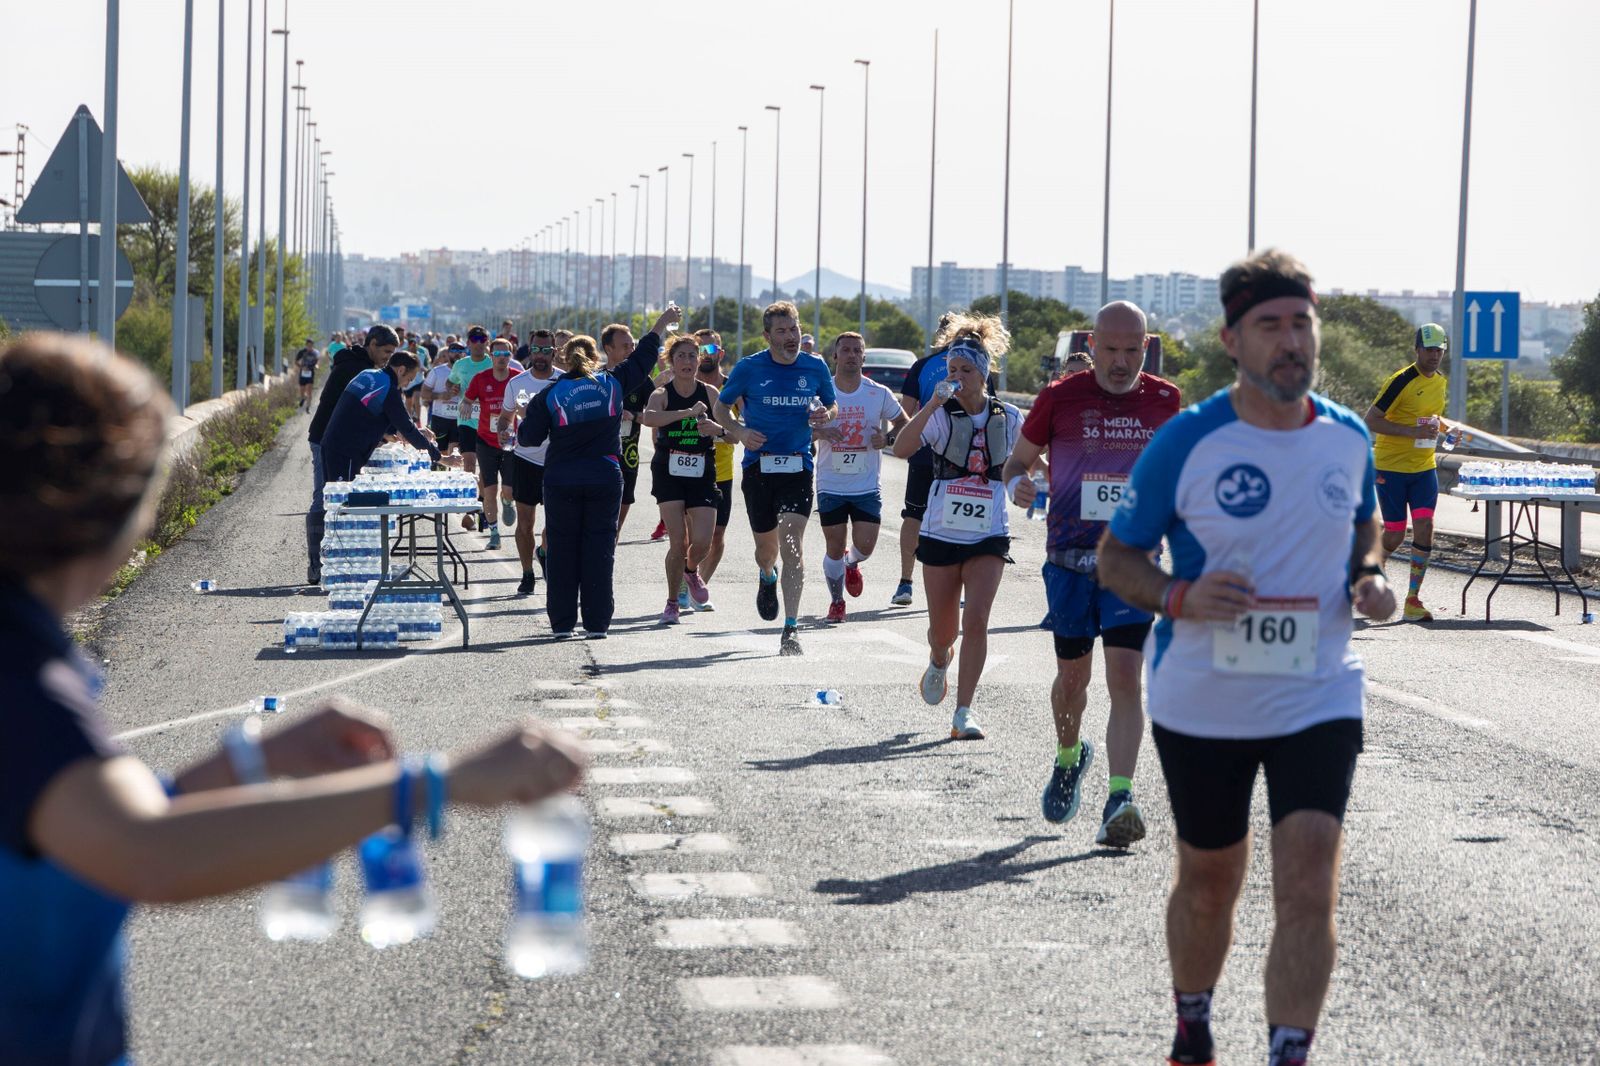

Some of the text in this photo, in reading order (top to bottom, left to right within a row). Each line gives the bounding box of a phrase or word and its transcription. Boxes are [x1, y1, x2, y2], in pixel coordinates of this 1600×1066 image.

[1103, 417, 1142, 428] MEDIA
[1082, 426, 1100, 439] 36
[677, 456, 698, 468] 682
[774, 456, 789, 465] 57
[843, 453, 857, 464] 27
[1097, 485, 1127, 503] 65
[951, 501, 986, 519] 792
[1239, 615, 1297, 645] 160
